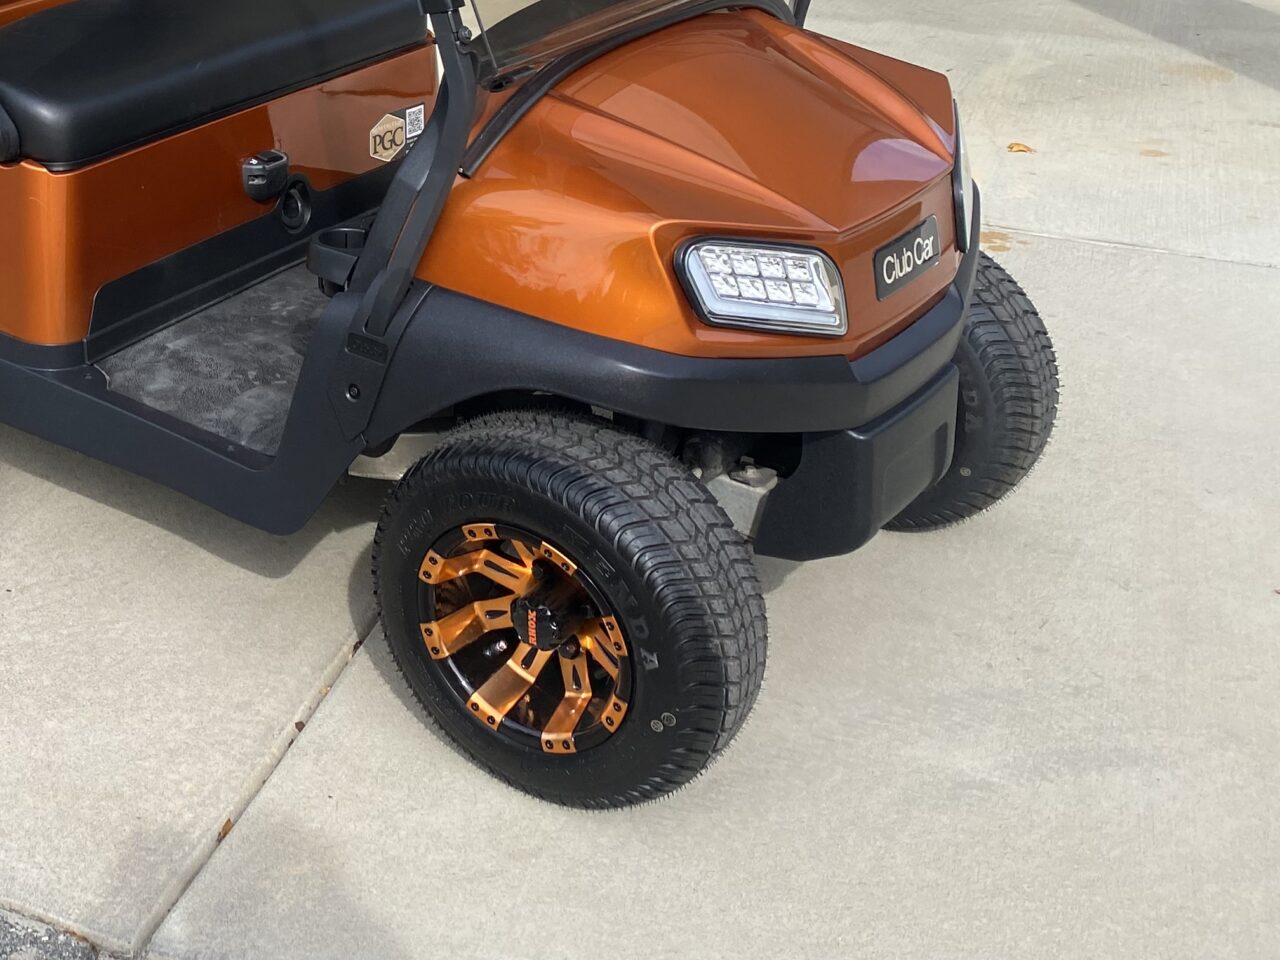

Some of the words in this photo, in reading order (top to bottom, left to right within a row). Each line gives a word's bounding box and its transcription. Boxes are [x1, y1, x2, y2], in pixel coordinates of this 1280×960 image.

[372, 126, 404, 156] PGC
[883, 247, 914, 285] Club
[913, 235, 934, 265] Car
[527, 608, 537, 646] RHOX
